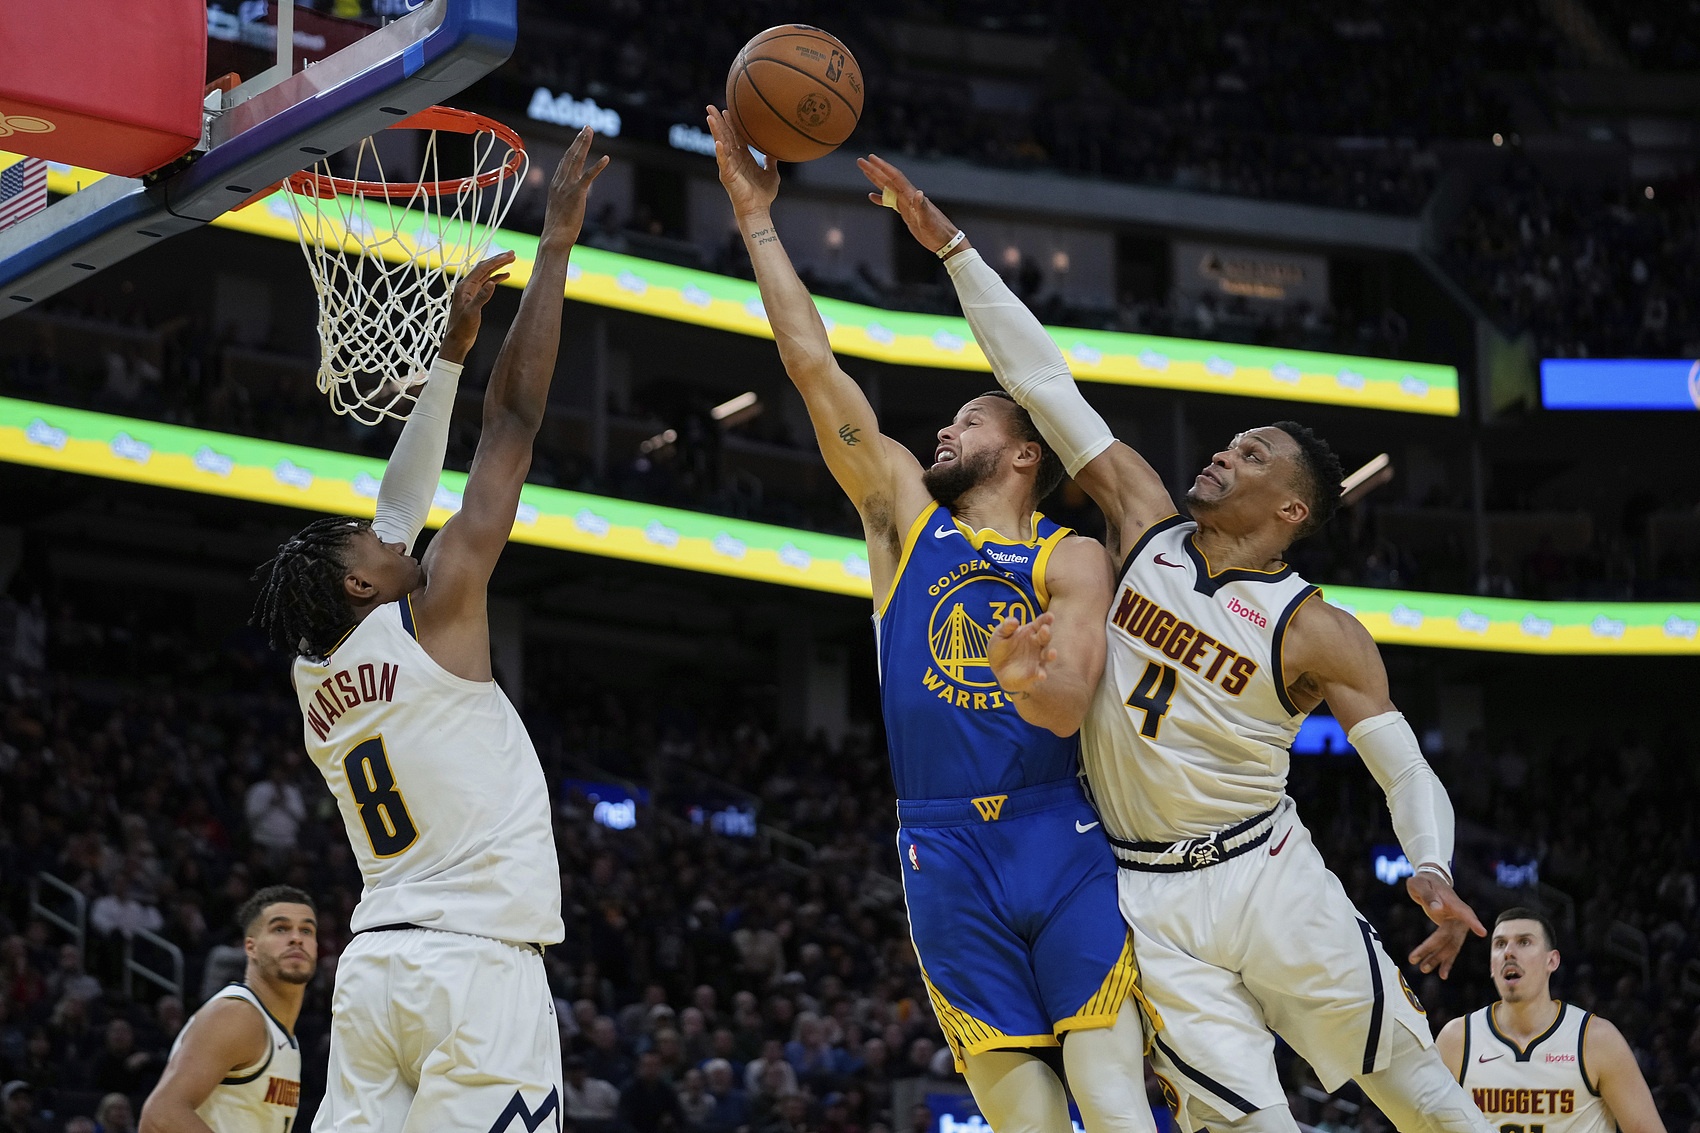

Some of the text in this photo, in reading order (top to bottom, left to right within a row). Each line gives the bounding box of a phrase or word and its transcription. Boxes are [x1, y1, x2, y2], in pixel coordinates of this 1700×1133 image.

[928, 560, 990, 596] GOLDEN
[1226, 597, 1268, 629] ibotta
[1112, 588, 1259, 697] NUGGETS
[308, 662, 399, 743] WATSON
[922, 666, 1013, 710] WARRI
[1124, 658, 1179, 741] 4
[342, 733, 420, 859] 8
[1545, 1053, 1576, 1063] ibotta
[1472, 1088, 1575, 1115] NUGGETS
